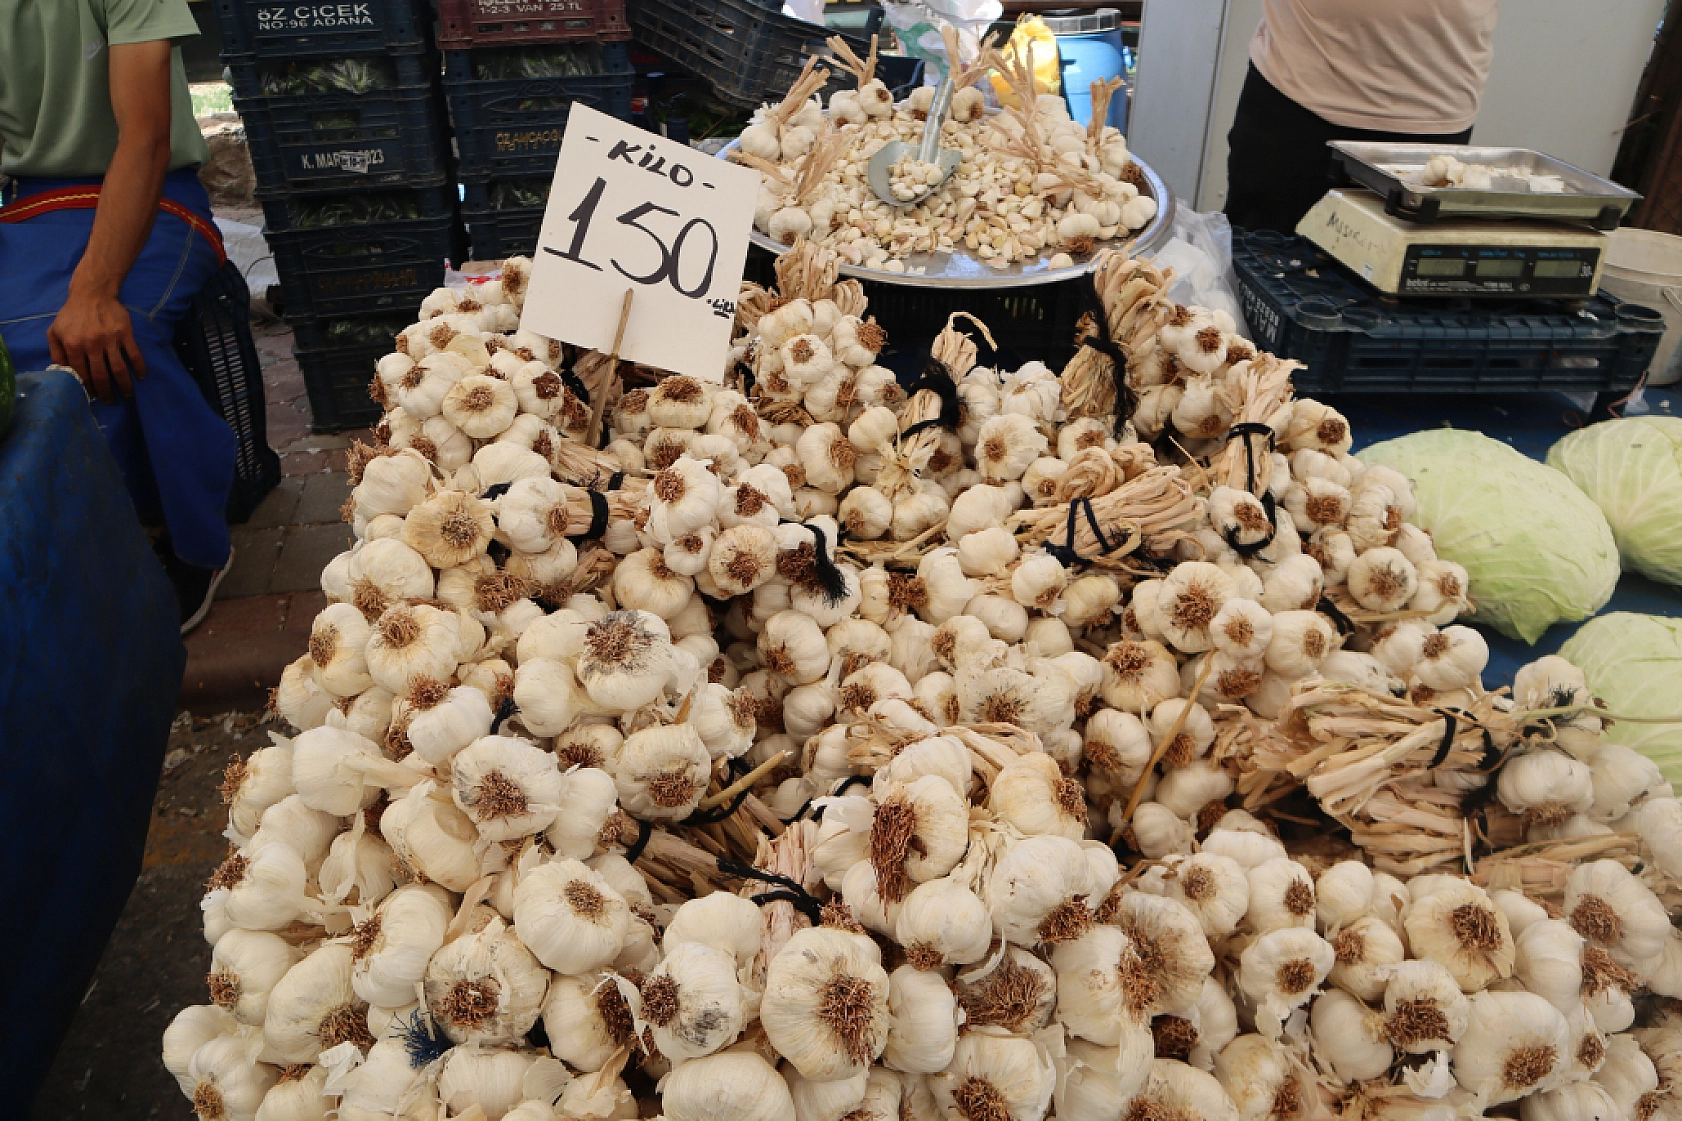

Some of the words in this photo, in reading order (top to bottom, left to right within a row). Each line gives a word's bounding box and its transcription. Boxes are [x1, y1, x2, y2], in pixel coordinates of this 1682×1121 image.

[516, 4, 544, 13] VAN
[313, 16, 374, 27] ADANA
[543, 176, 719, 299] 150
